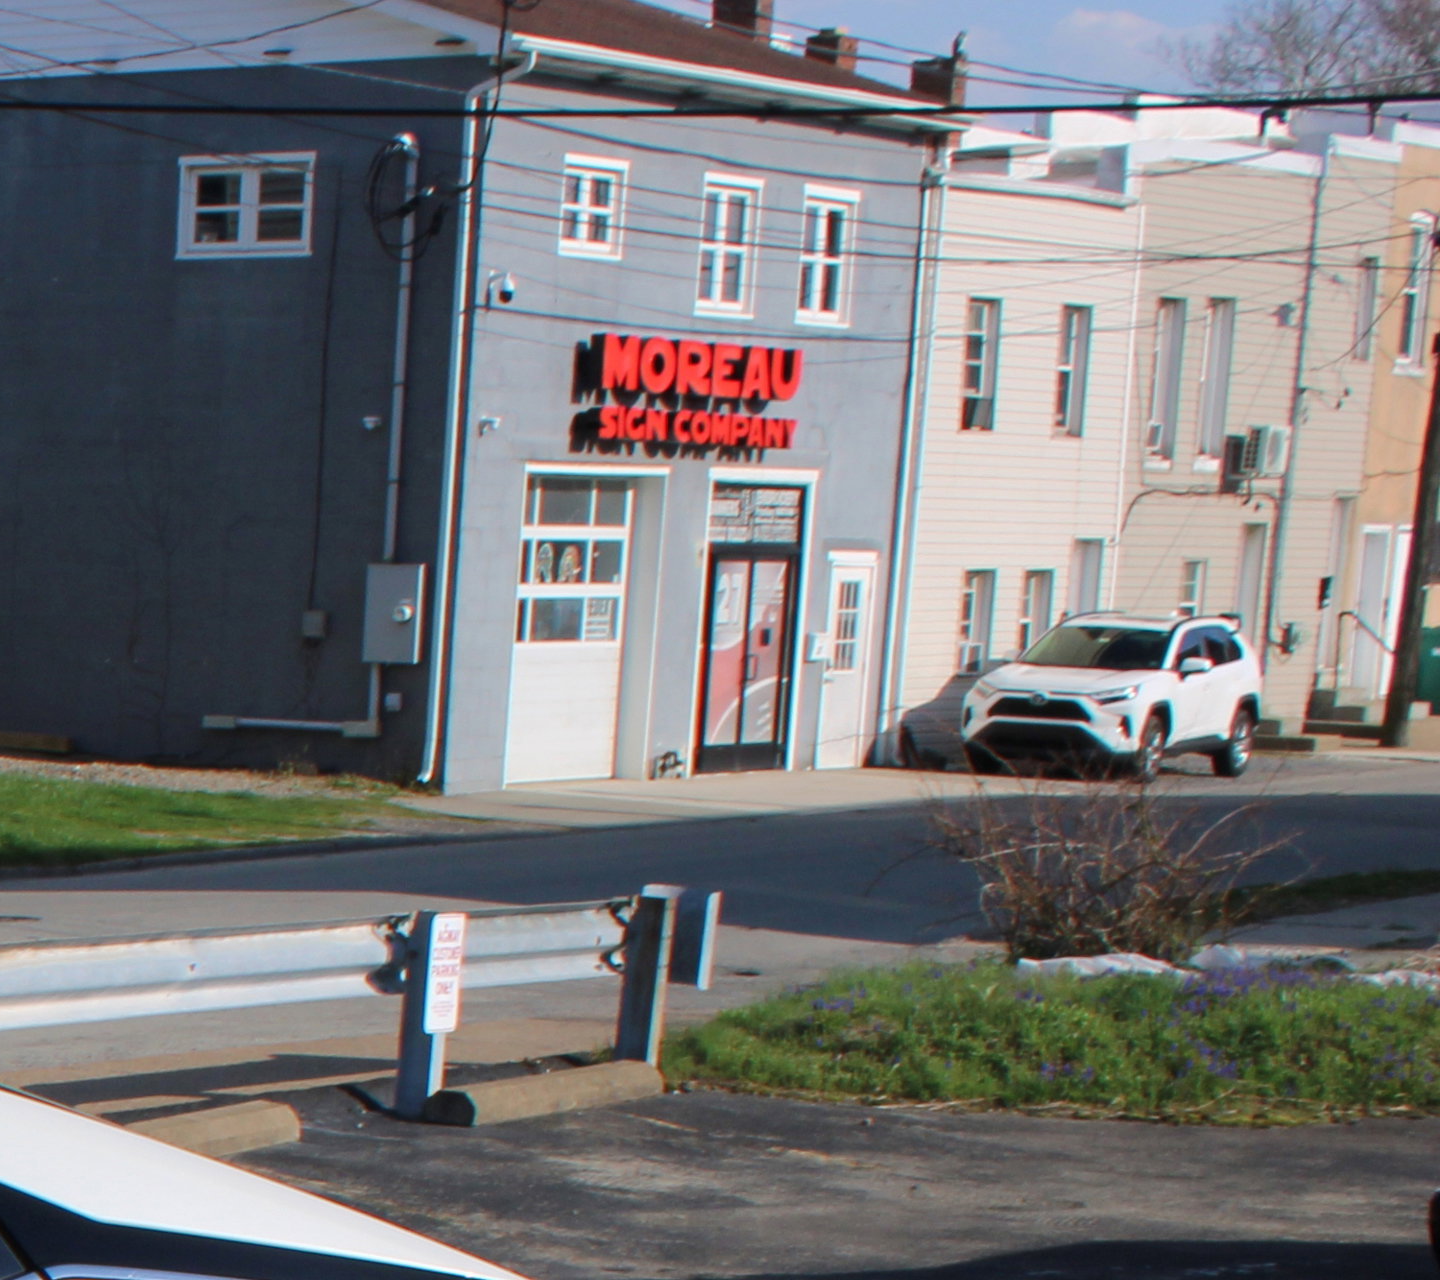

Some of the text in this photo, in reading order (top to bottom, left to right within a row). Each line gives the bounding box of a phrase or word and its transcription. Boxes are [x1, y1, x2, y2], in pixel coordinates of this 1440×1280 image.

[601, 333, 804, 401] MOREAU
[599, 406, 797, 449] SIGN COMPANY
